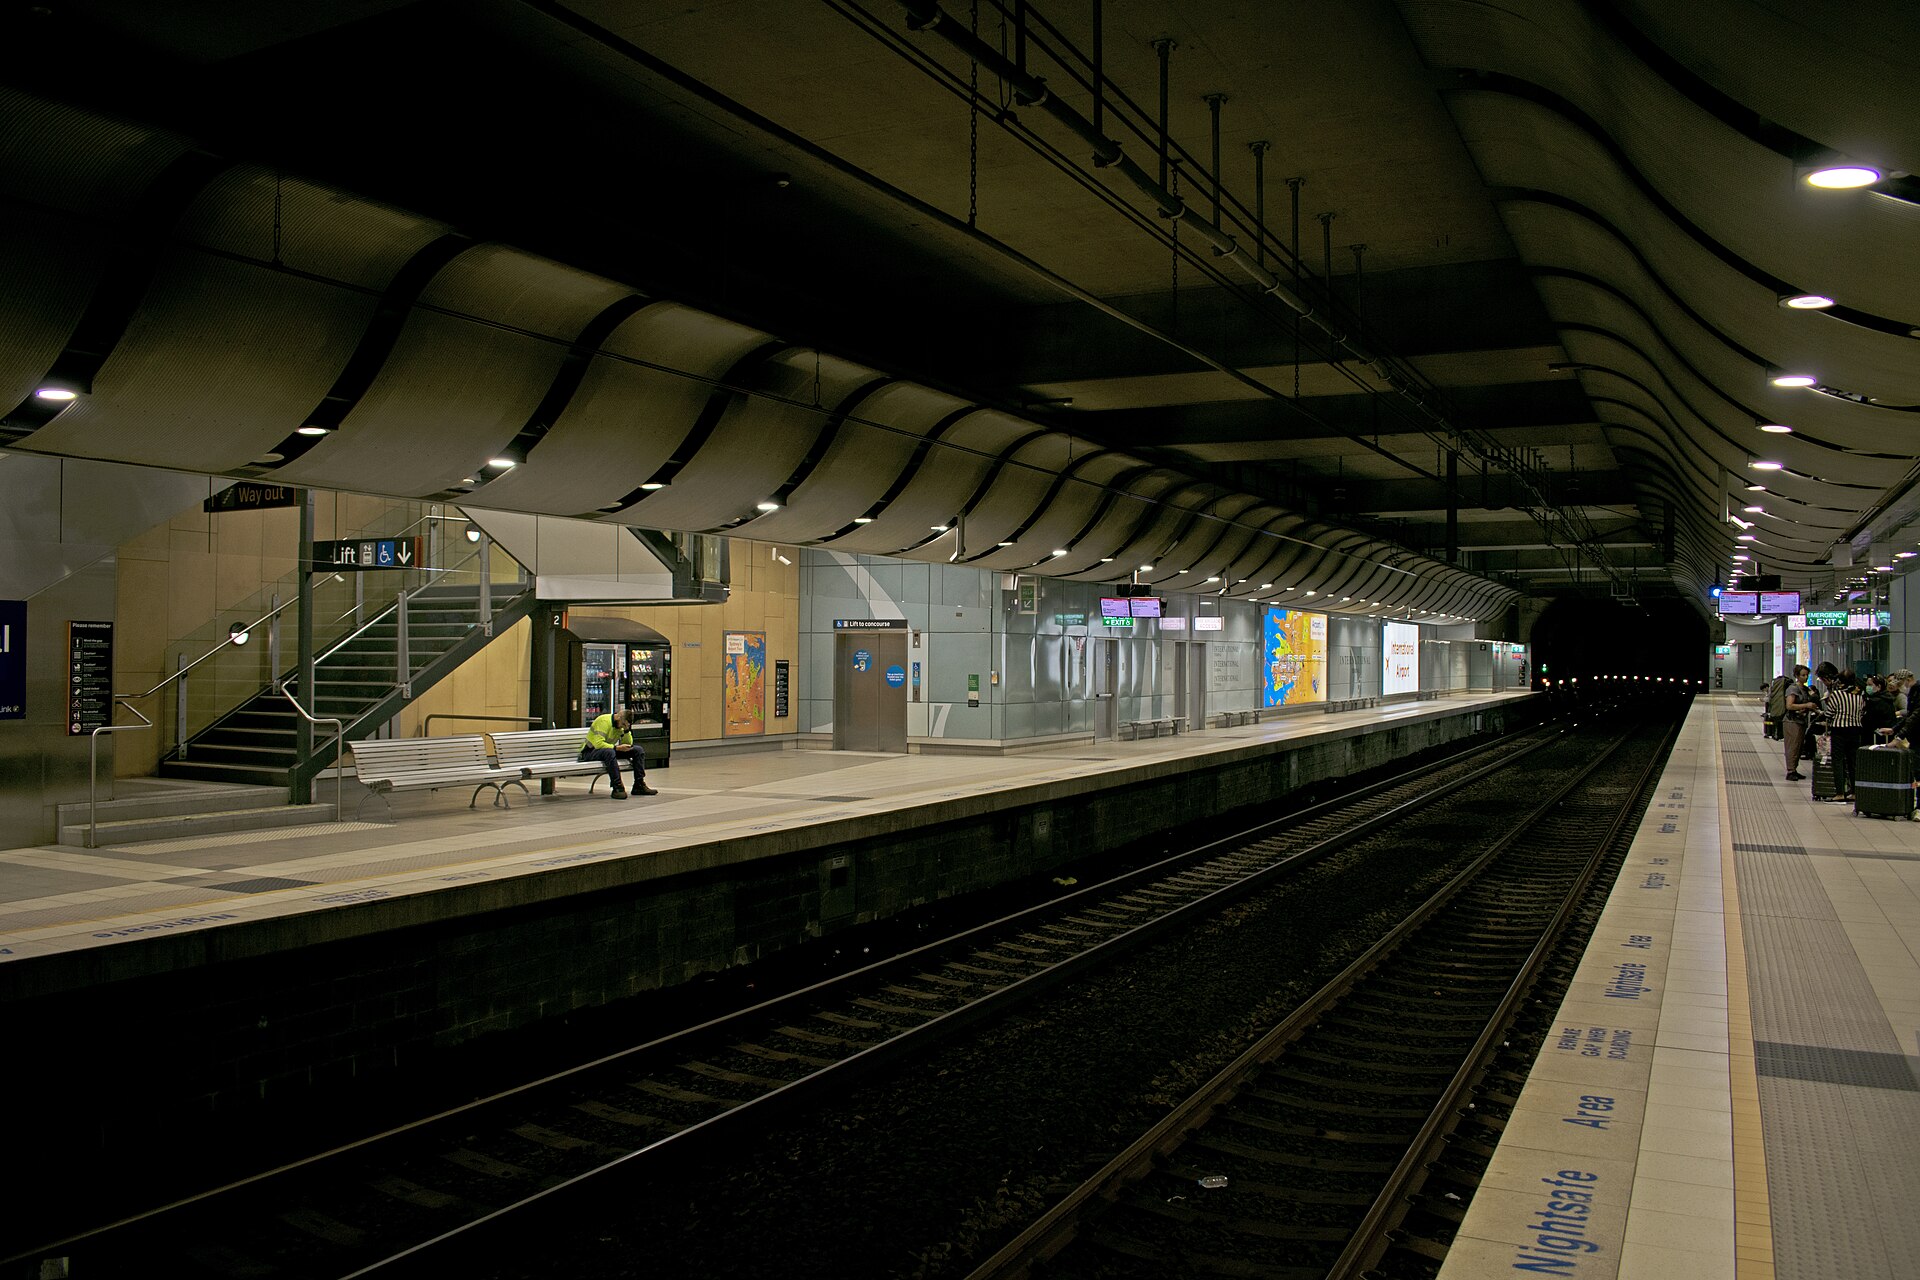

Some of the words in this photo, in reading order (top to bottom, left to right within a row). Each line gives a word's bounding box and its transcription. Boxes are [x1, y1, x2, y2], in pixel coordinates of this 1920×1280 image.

[238, 487, 262, 505] Way
[265, 485, 284, 500] out
[333, 546, 356, 564] Lift
[553, 615, 560, 625] 2
[1391, 640, 1414, 655] International
[1396, 664, 1410, 680] Airport
[1620, 935, 1652, 950] Area
[1604, 963, 1652, 1000] Nightsafe
[1557, 1028, 1582, 1050] BEWARE
[1586, 1026, 1608, 1042] WHEN
[1581, 1044, 1602, 1056] GAP
[1607, 1030, 1632, 1059] BOARDING
[1512, 1169, 1599, 1276] Nightsafe
[1562, 1094, 1615, 1130] Area
